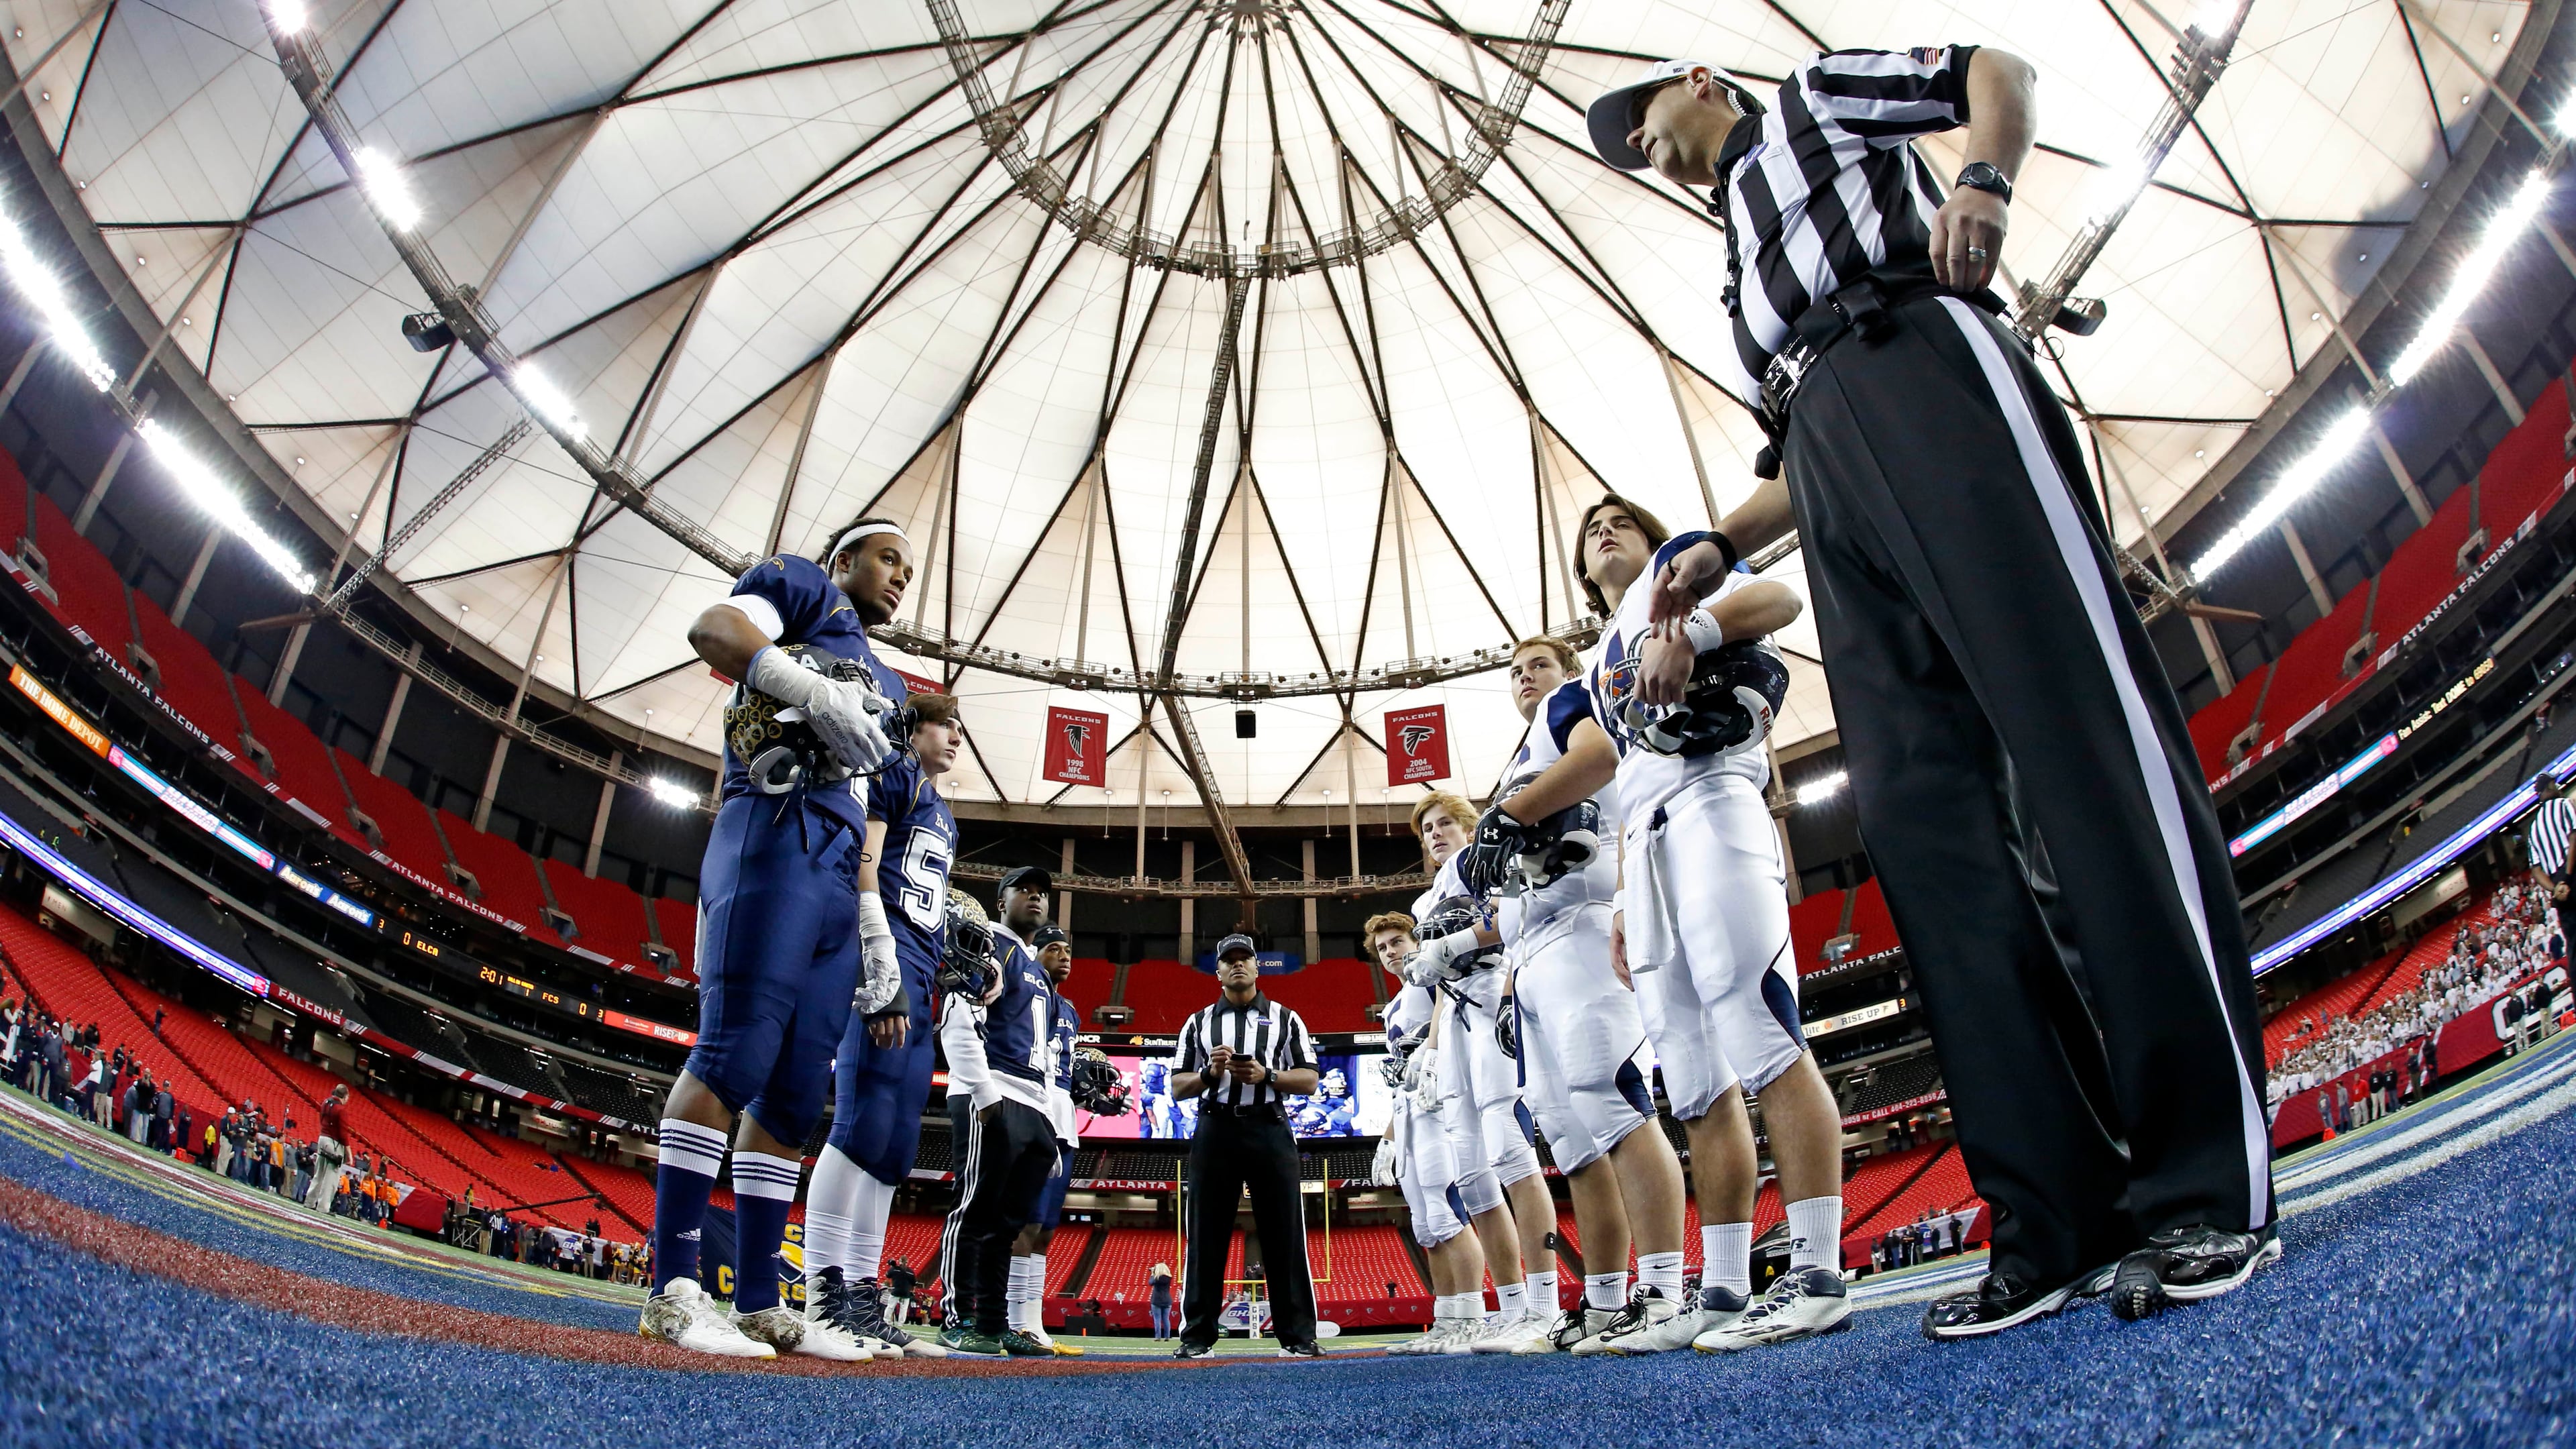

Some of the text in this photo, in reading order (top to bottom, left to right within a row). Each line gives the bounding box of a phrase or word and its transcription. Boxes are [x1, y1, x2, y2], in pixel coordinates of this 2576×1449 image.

[2402, 537, 2515, 645] ATLANTA FALCONS
[95, 646, 210, 745] ATLANTA FALCONS
[907, 682, 936, 694] CONS
[2445, 680, 2468, 704] DOME
[19, 672, 103, 750] THE HOME DEPOT
[1056, 714, 1101, 724] FALCONS
[1392, 712, 1438, 722] FALCONS
[822, 712, 849, 744] adizero
[1067, 759, 1084, 767] 1998
[1409, 758, 1428, 767] 2004
[1059, 771, 1090, 781] CHAMPIONS
[1404, 770, 1435, 780] CHAMPIONS
[900, 826, 953, 933] 5
[279, 865, 372, 924] Aaron's Aaron's
[392, 862, 503, 923] ATLANTA FALCONS
[378, 918, 385, 929] 3
[403, 932, 439, 957] 0 ELCA
[1805, 946, 1901, 980] ATLANTA FALC
[278, 987, 341, 1025] FALCONS
[542, 992, 559, 1004] FCS
[579, 1003, 587, 1016] 0
[1841, 1014, 1864, 1026] RISE
[1866, 1009, 1879, 1018] UP
[654, 1026, 689, 1042] RISE UP
[1028, 994, 1047, 1073] 1
[1079, 1034, 1100, 1043] NCR
[1872, 1108, 1889, 1118] CALL
[1097, 1181, 1167, 1189] ATLANTA
